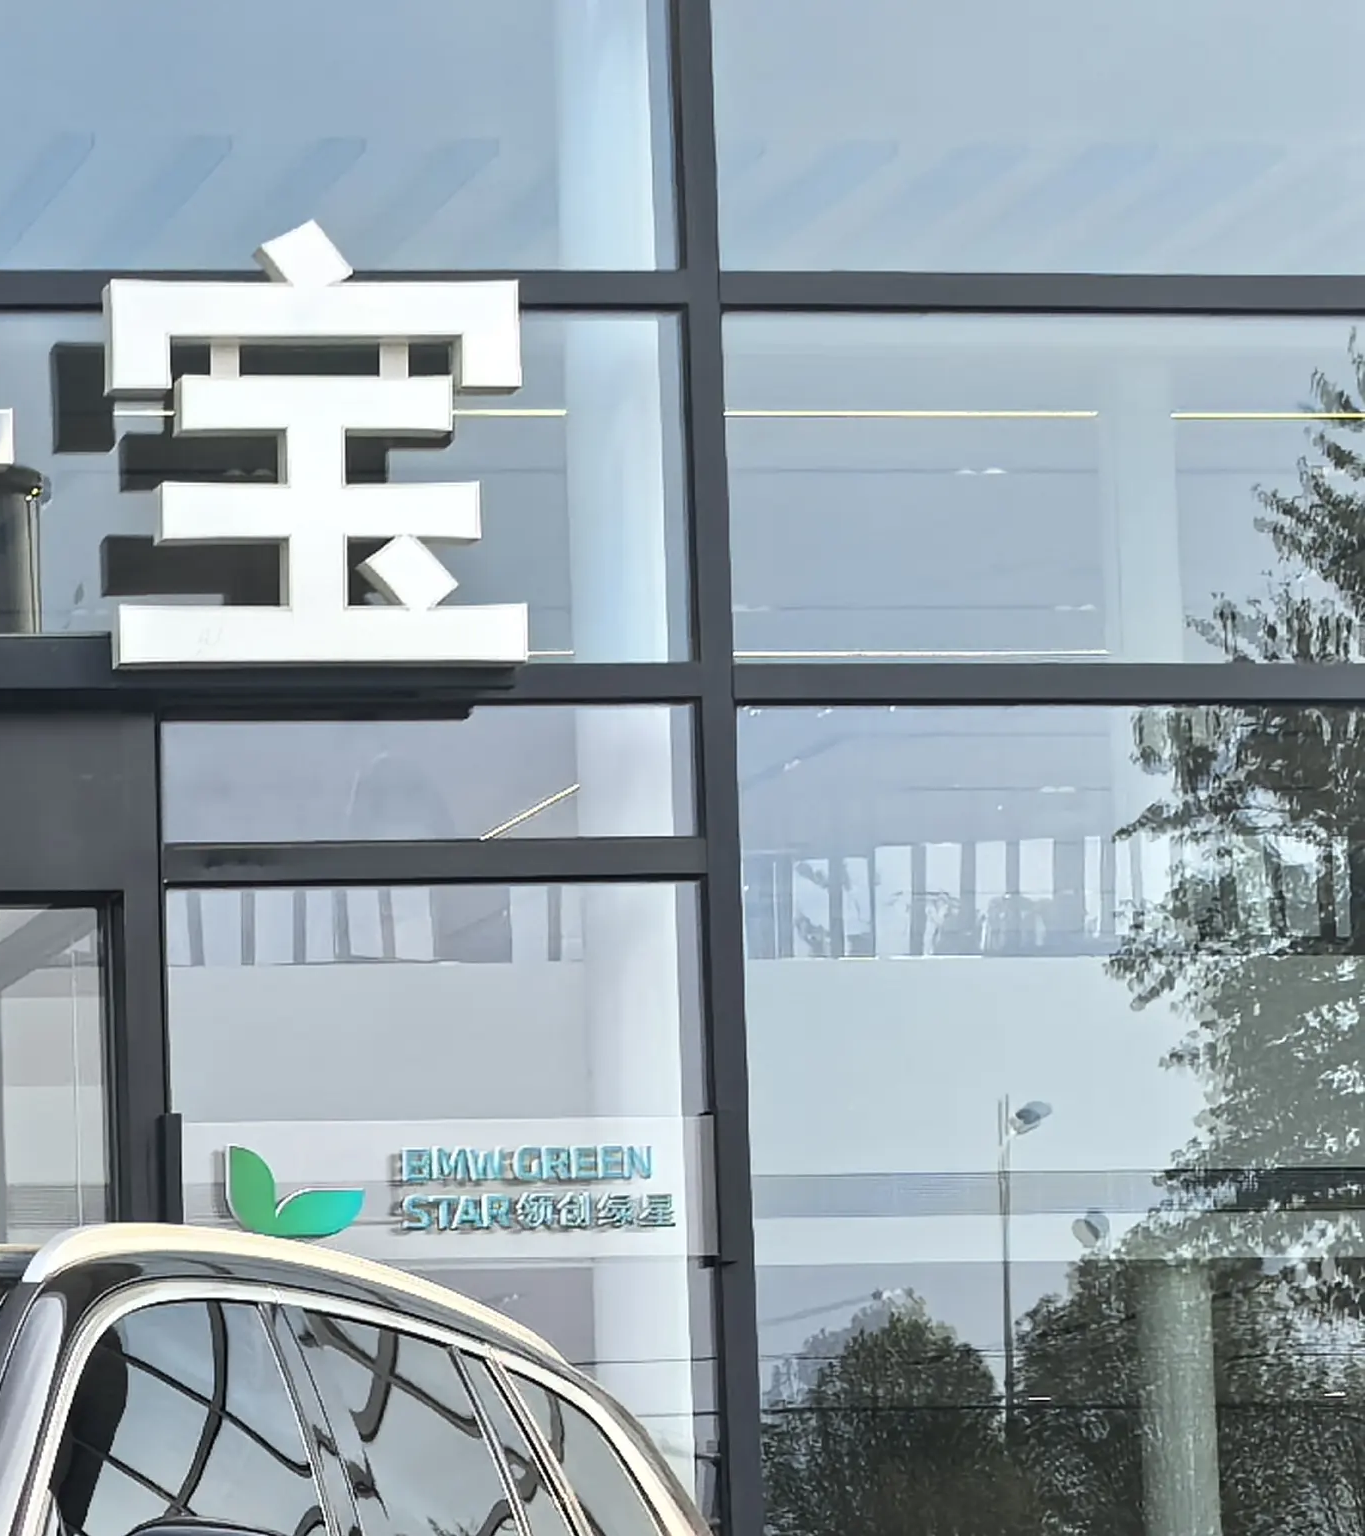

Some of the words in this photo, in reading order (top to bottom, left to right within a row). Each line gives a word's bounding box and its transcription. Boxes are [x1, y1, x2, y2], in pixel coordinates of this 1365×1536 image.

[400, 1146, 501, 1182] BMW
[513, 1145, 652, 1180] GREEN
[400, 1195, 510, 1230] STAR
